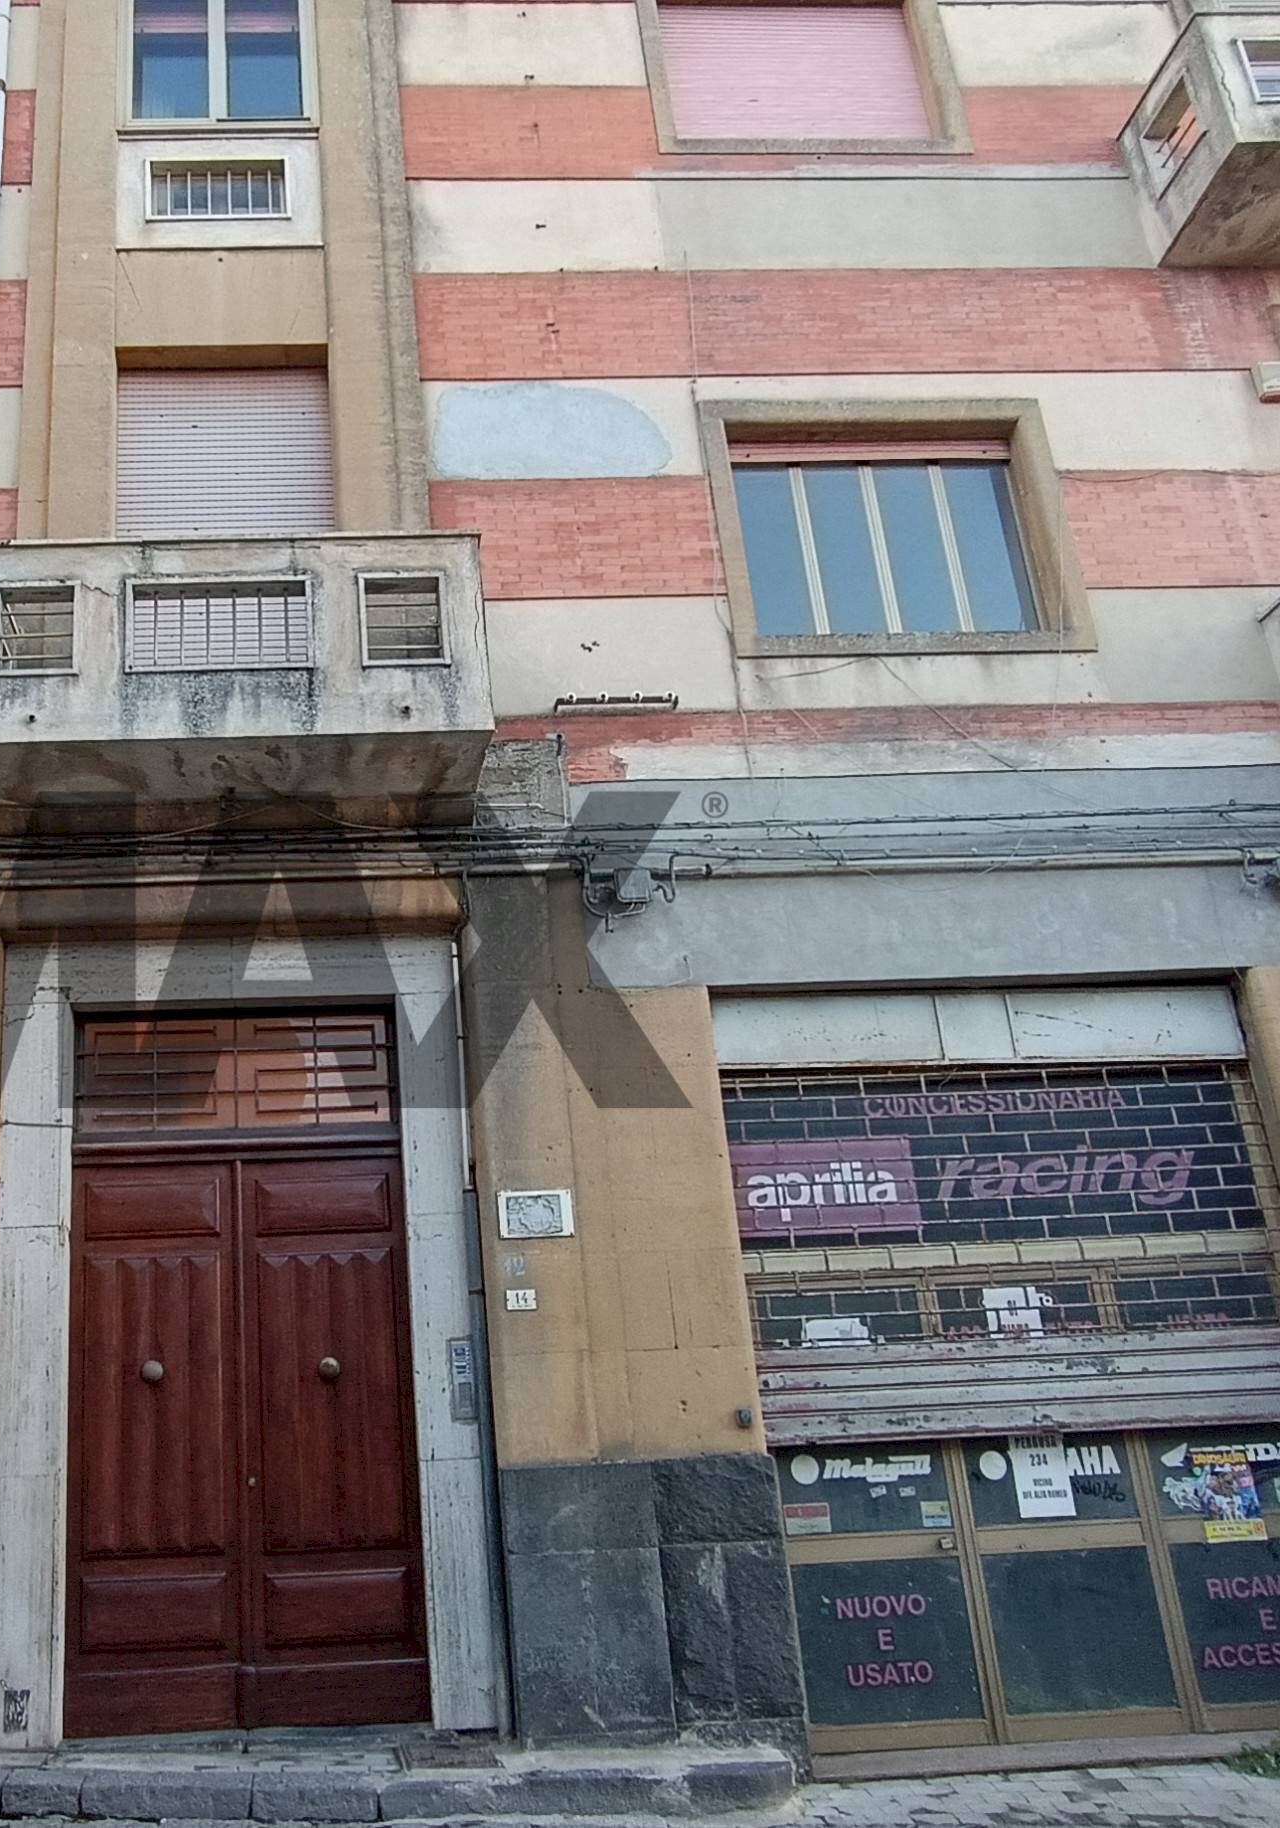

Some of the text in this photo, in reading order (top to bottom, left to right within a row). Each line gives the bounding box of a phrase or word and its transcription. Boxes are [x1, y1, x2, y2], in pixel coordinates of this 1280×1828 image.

[863, 1087, 1126, 1118] CONCESSIONARIA
[746, 1144, 1196, 1221] aprilia racing
[514, 1291, 528, 1305] 14
[1029, 1453, 1048, 1467] 234
[835, 1594, 926, 1620] NUOVO
[1258, 1608, 1277, 1631] E
[878, 1629, 895, 1651] E
[847, 1661, 933, 1688] USATO
